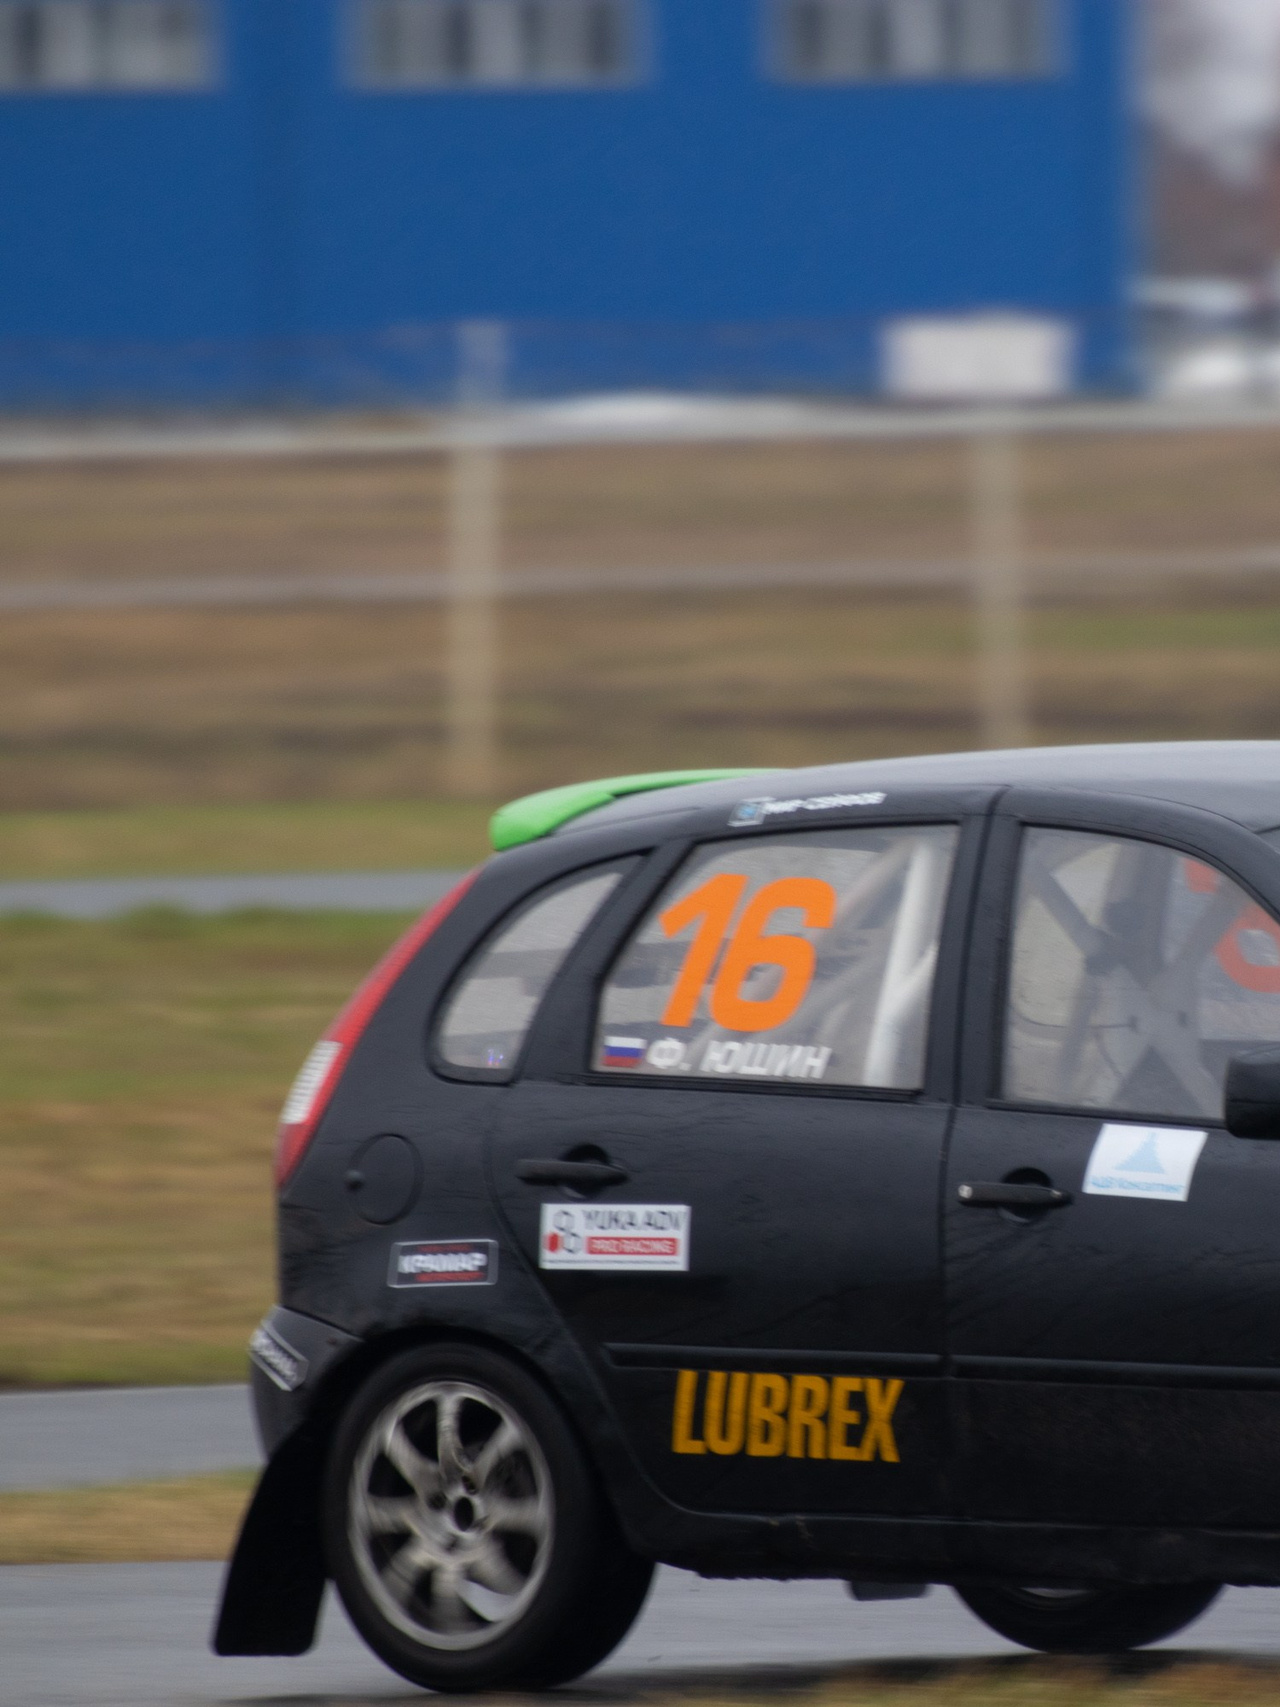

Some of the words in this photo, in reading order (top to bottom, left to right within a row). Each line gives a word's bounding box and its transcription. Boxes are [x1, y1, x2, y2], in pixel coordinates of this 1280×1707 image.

[658, 872, 838, 1033] 16
[700, 1039, 833, 1080] ЮШИН
[672, 1368, 906, 1463] LUBREX
